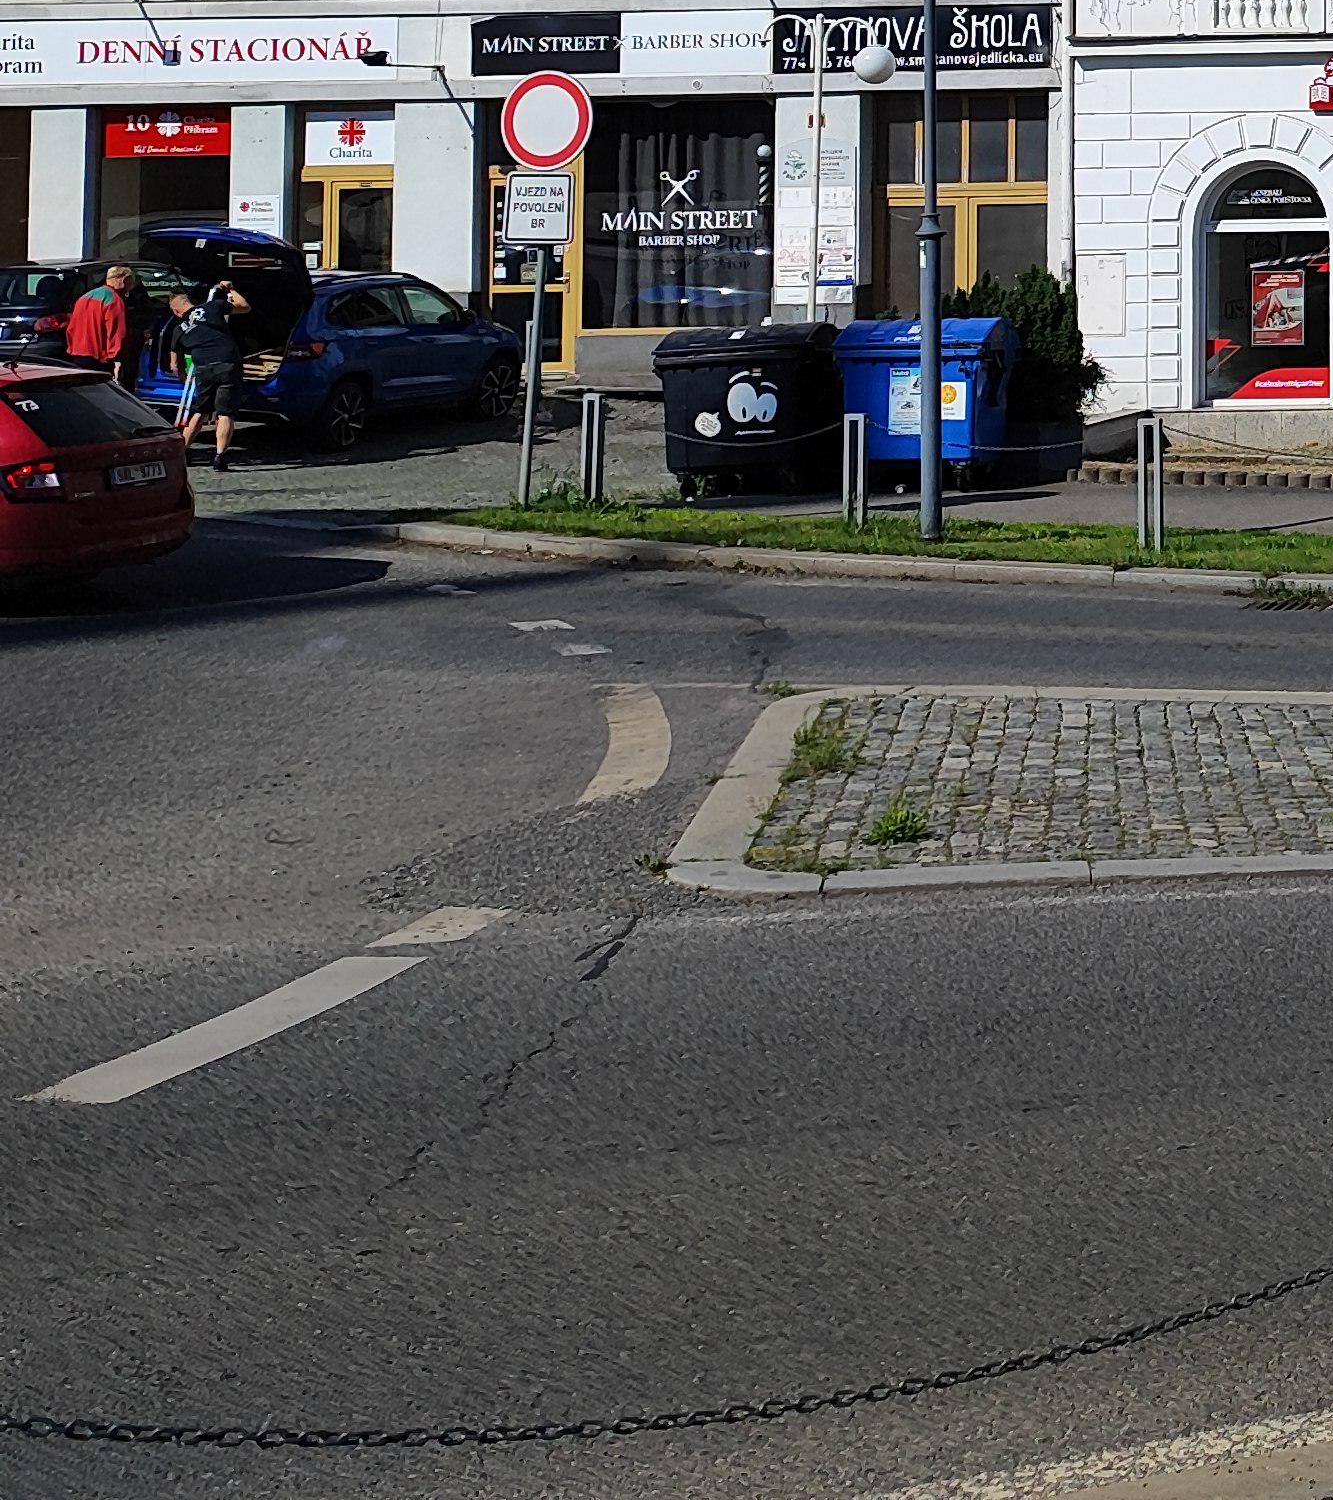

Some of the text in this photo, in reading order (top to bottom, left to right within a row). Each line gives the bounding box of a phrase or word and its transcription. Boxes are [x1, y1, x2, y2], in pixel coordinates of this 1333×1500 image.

[950, 7, 1043, 49] ŠKOLA
[0, 33, 35, 51] rita
[77, 31, 372, 64] DENNÍ STACIONÁŘ
[482, 33, 609, 54] MAIN STREET
[631, 33, 762, 50] BARBER SHOP
[894, 51, 1044, 68] w.smanovajedlicka.eu
[329, 147, 373, 158] Charita
[515, 187, 564, 197] VJEZD NA
[513, 201, 565, 213] POVOLENÍ
[601, 207, 758, 231] MAIN STREET
[638, 234, 721, 247] BARBER SHOP
